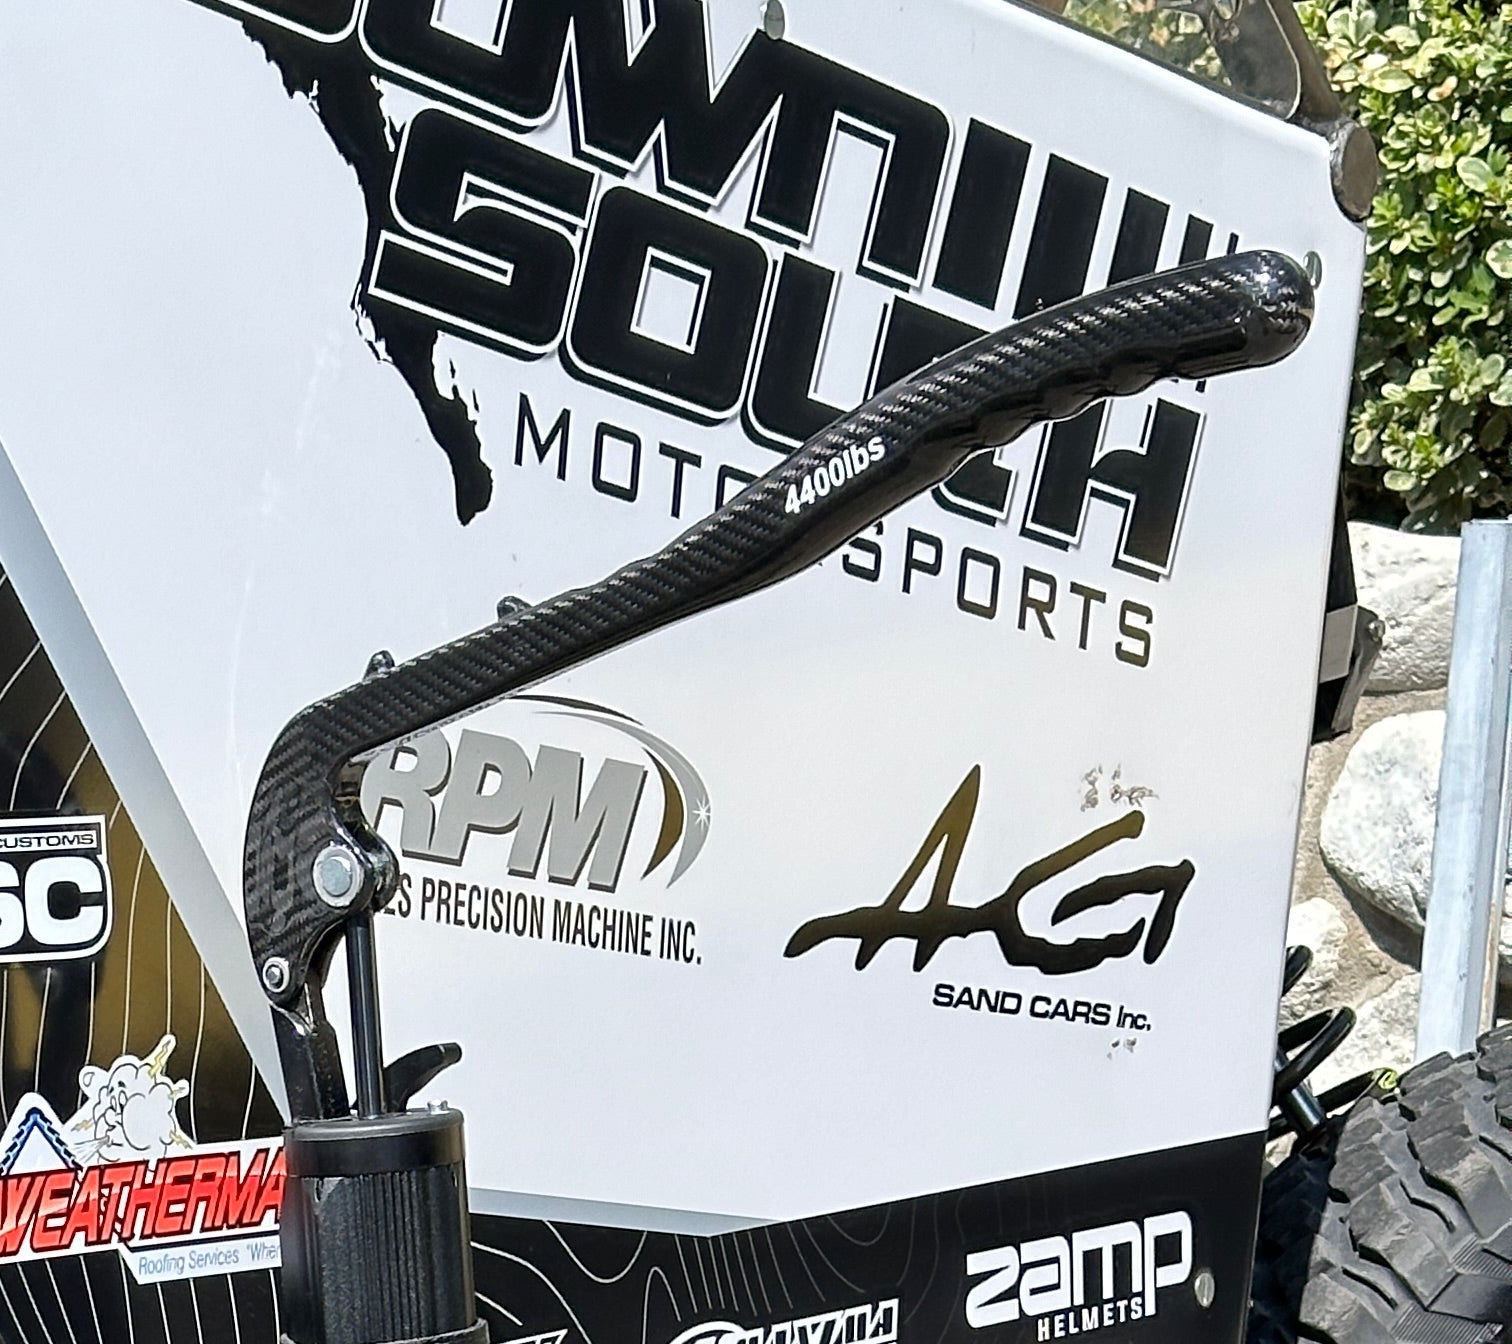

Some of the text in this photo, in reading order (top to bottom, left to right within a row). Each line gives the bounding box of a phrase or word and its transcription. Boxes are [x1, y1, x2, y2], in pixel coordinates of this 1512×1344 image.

[200, 0, 954, 292] OWN
[784, 438, 886, 515] 4400lbs
[513, 392, 1156, 670] MOTSPORTS
[360, 727, 648, 894] RPM
[420, 876, 545, 940] PRECISION
[551, 898, 653, 957] MACHINE
[659, 917, 703, 966] INC.
[932, 982, 1152, 1032] SAND CARS Inc.
[138, 1252, 185, 1276] Roofing
[188, 1243, 240, 1270] Services
[965, 1210, 1193, 1329] zamp
[1037, 1296, 1143, 1342] HELMETS
